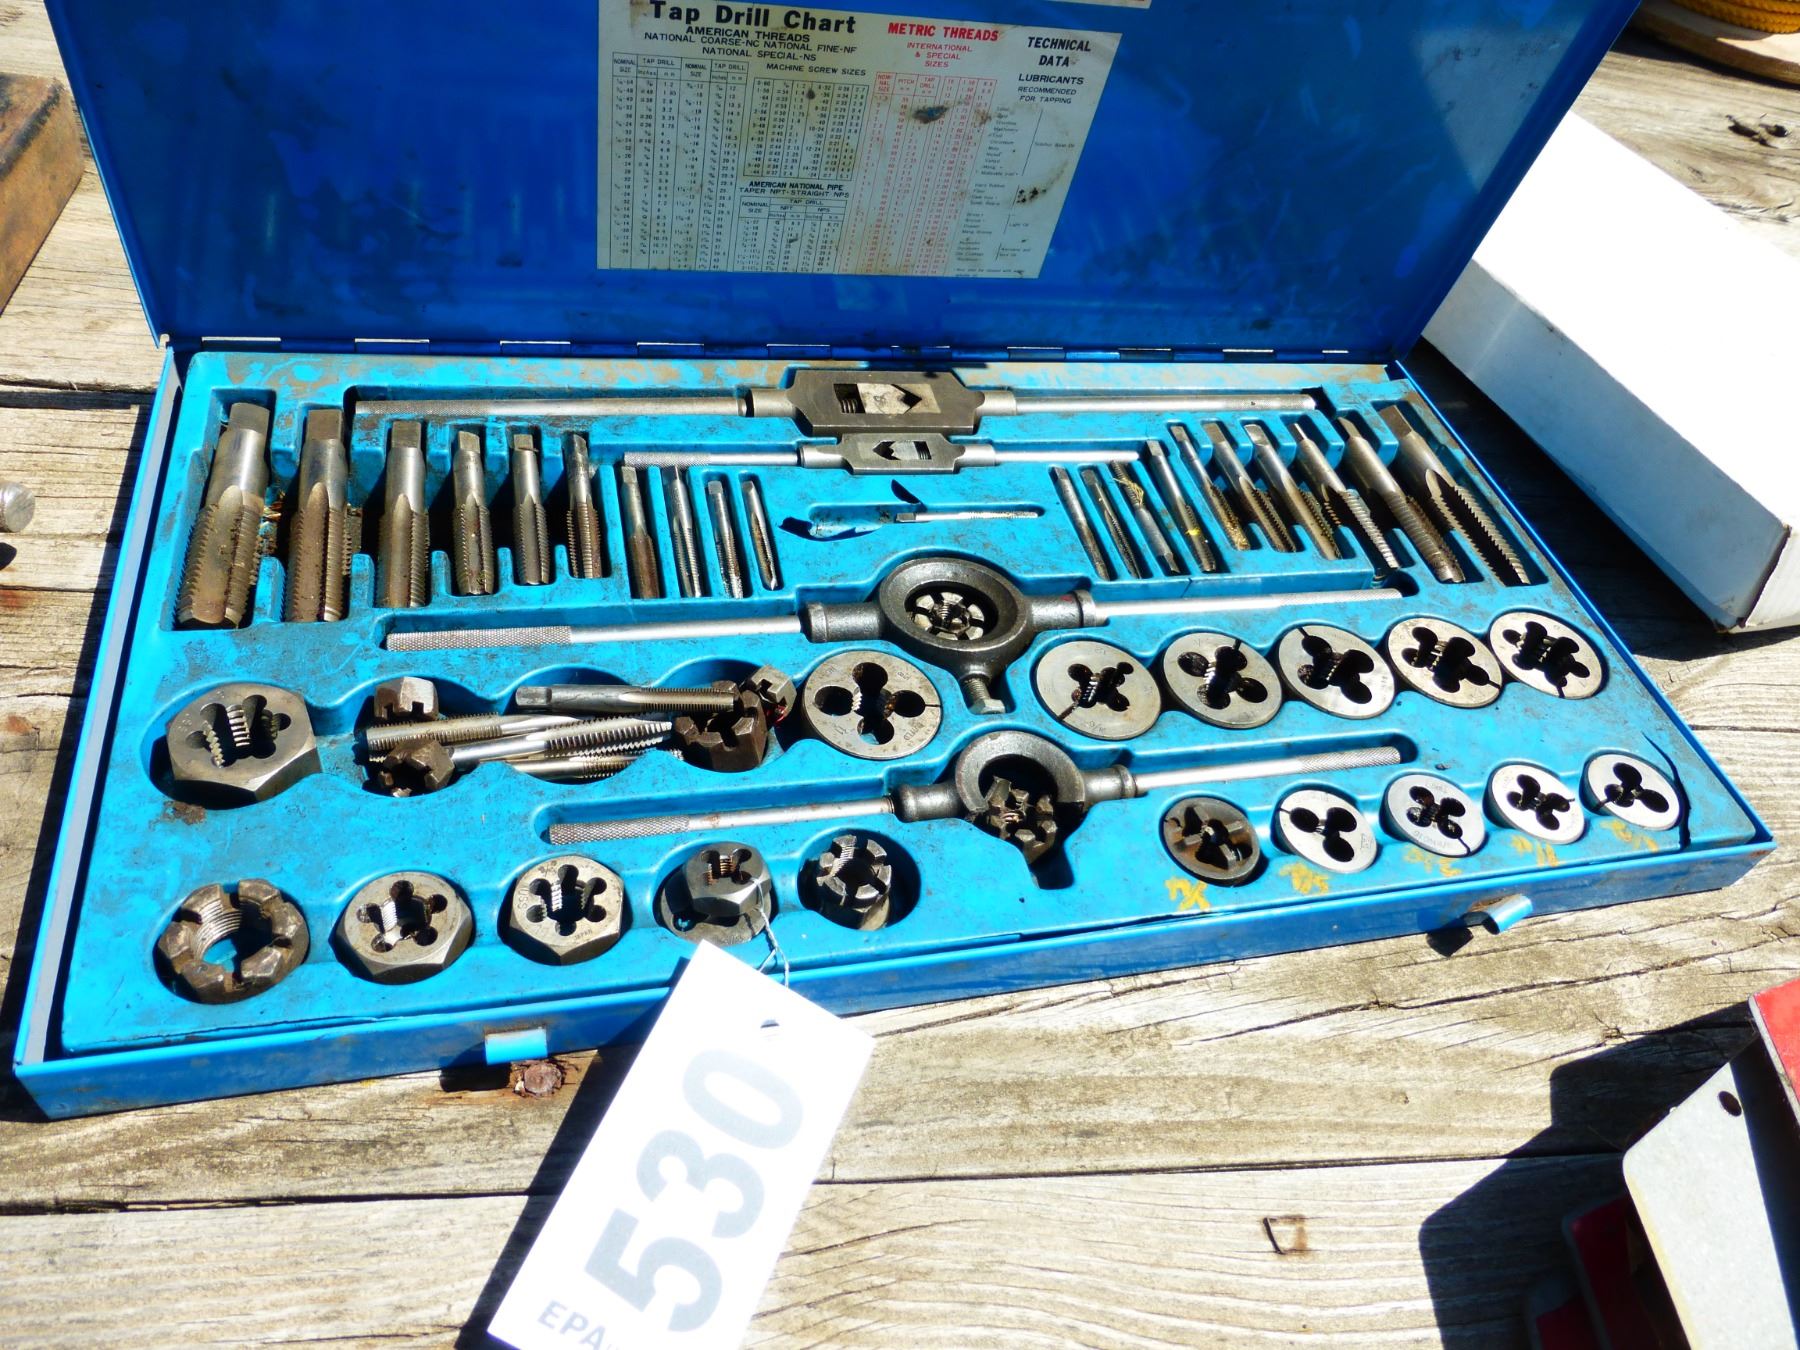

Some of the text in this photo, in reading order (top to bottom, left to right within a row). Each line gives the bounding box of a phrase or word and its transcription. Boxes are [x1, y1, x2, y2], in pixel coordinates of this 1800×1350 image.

[651, 1, 856, 33] Tap Drill Chart
[686, 26, 810, 42] AMERICAN THREADS
[888, 23, 998, 41] METRIC THREADS
[644, 32, 857, 54] NATIONAL COARSE-NC NATIONAL FINE-NF
[906, 41, 972, 52] INTERNATIONAL
[1028, 37, 1091, 51] TECHNICAL
[702, 47, 817, 61] NATIONAL SPECIAL-NS
[926, 52, 961, 61] SPECIAL
[1038, 55, 1070, 68] DATA
[766, 63, 804, 72] MACHINE
[808, 66, 838, 74] SCREW
[1018, 74, 1084, 85] LUBRICANTS
[1017, 86, 1077, 95] RECOMMENDED
[1019, 95, 1036, 103] FOR
[584, 1050, 803, 1332] 530
